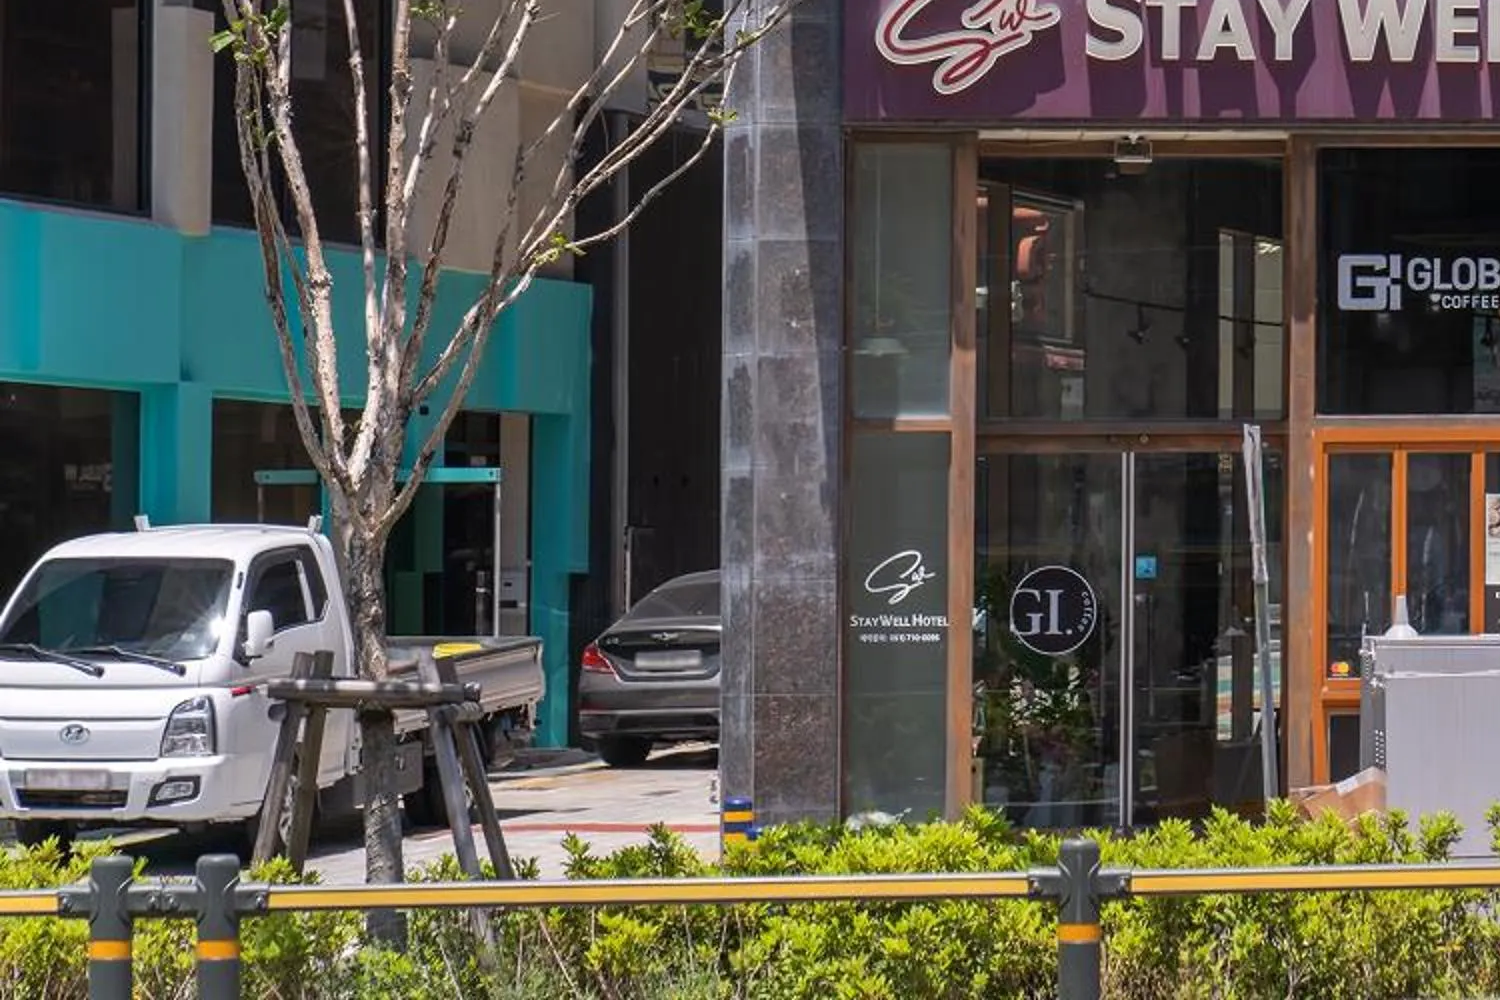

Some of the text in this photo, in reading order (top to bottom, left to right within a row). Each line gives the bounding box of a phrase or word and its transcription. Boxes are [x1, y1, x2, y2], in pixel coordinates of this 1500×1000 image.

[1441, 294, 1500, 309] COFFEE
[850, 612, 950, 627] STAY WELL HOTEL
